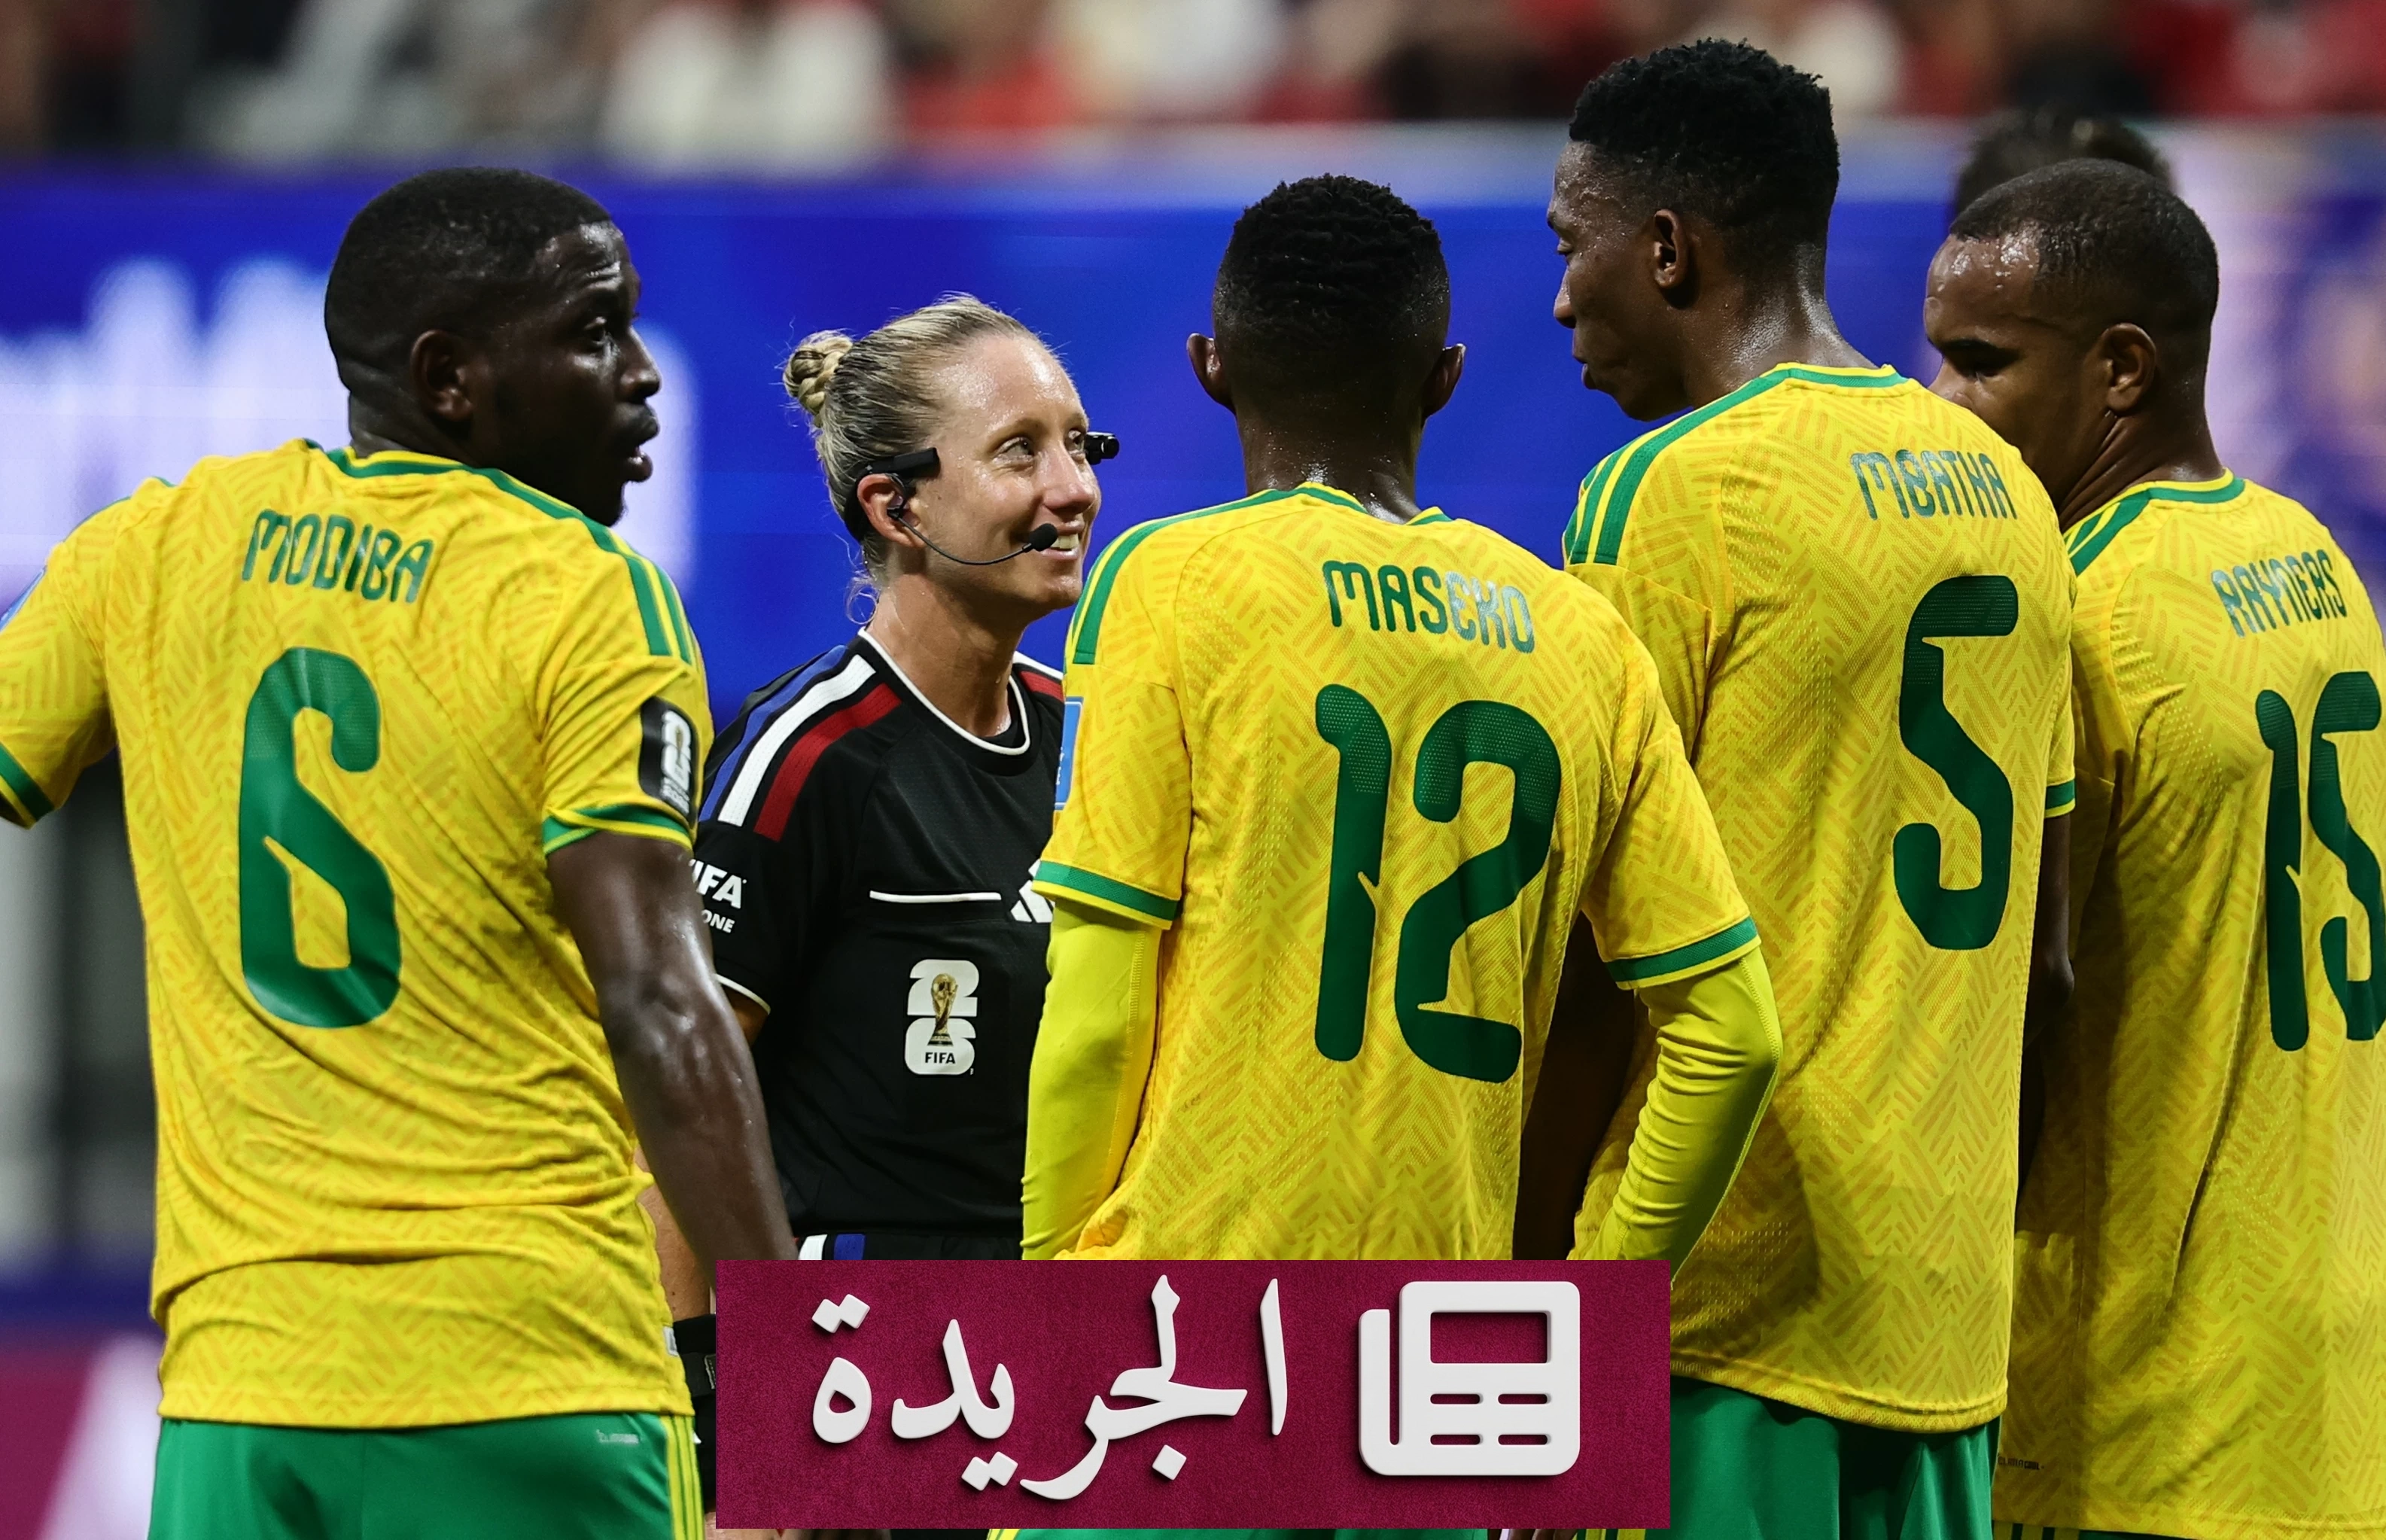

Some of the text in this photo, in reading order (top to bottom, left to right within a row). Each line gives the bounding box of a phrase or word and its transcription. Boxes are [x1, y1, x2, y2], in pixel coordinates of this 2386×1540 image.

[1849, 449, 2018, 522] MBATHA
[242, 510, 434, 603] MODIBA
[2210, 549, 2348, 638] RAYNERS
[1322, 559, 1535, 654] MASEKO
[1893, 575, 2019, 951] 5
[239, 647, 401, 1029] 6
[688, 858, 742, 909] IFA
[1315, 683, 1562, 1084] 12
[2256, 671, 2386, 1052] 15
[925, 1052, 956, 1064] FIFA
